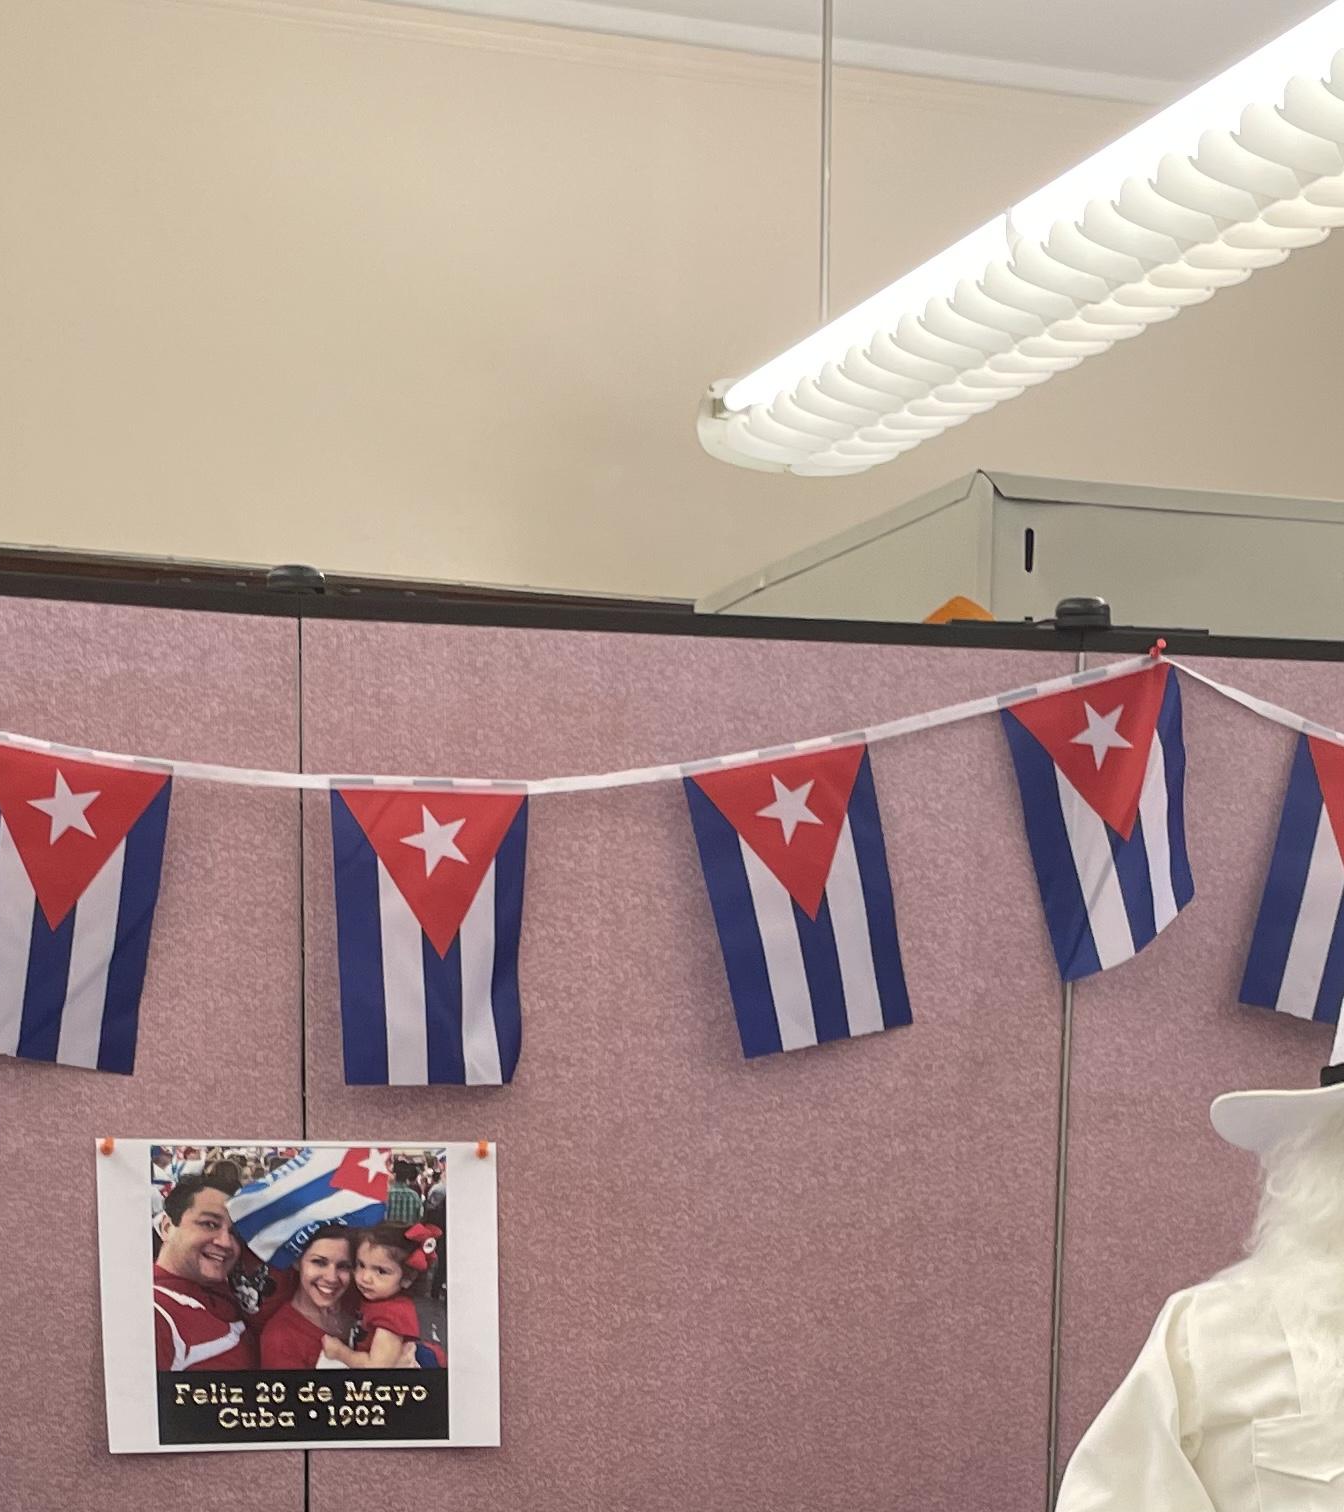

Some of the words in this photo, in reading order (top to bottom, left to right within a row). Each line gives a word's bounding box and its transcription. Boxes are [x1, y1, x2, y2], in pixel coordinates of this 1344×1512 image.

[175, 1383, 244, 1405] Feliz
[256, 1382, 286, 1403] 20
[298, 1382, 332, 1403] de
[344, 1381, 427, 1406] Mayo
[218, 1407, 295, 1428] Cuba
[327, 1405, 386, 1427] 1902
